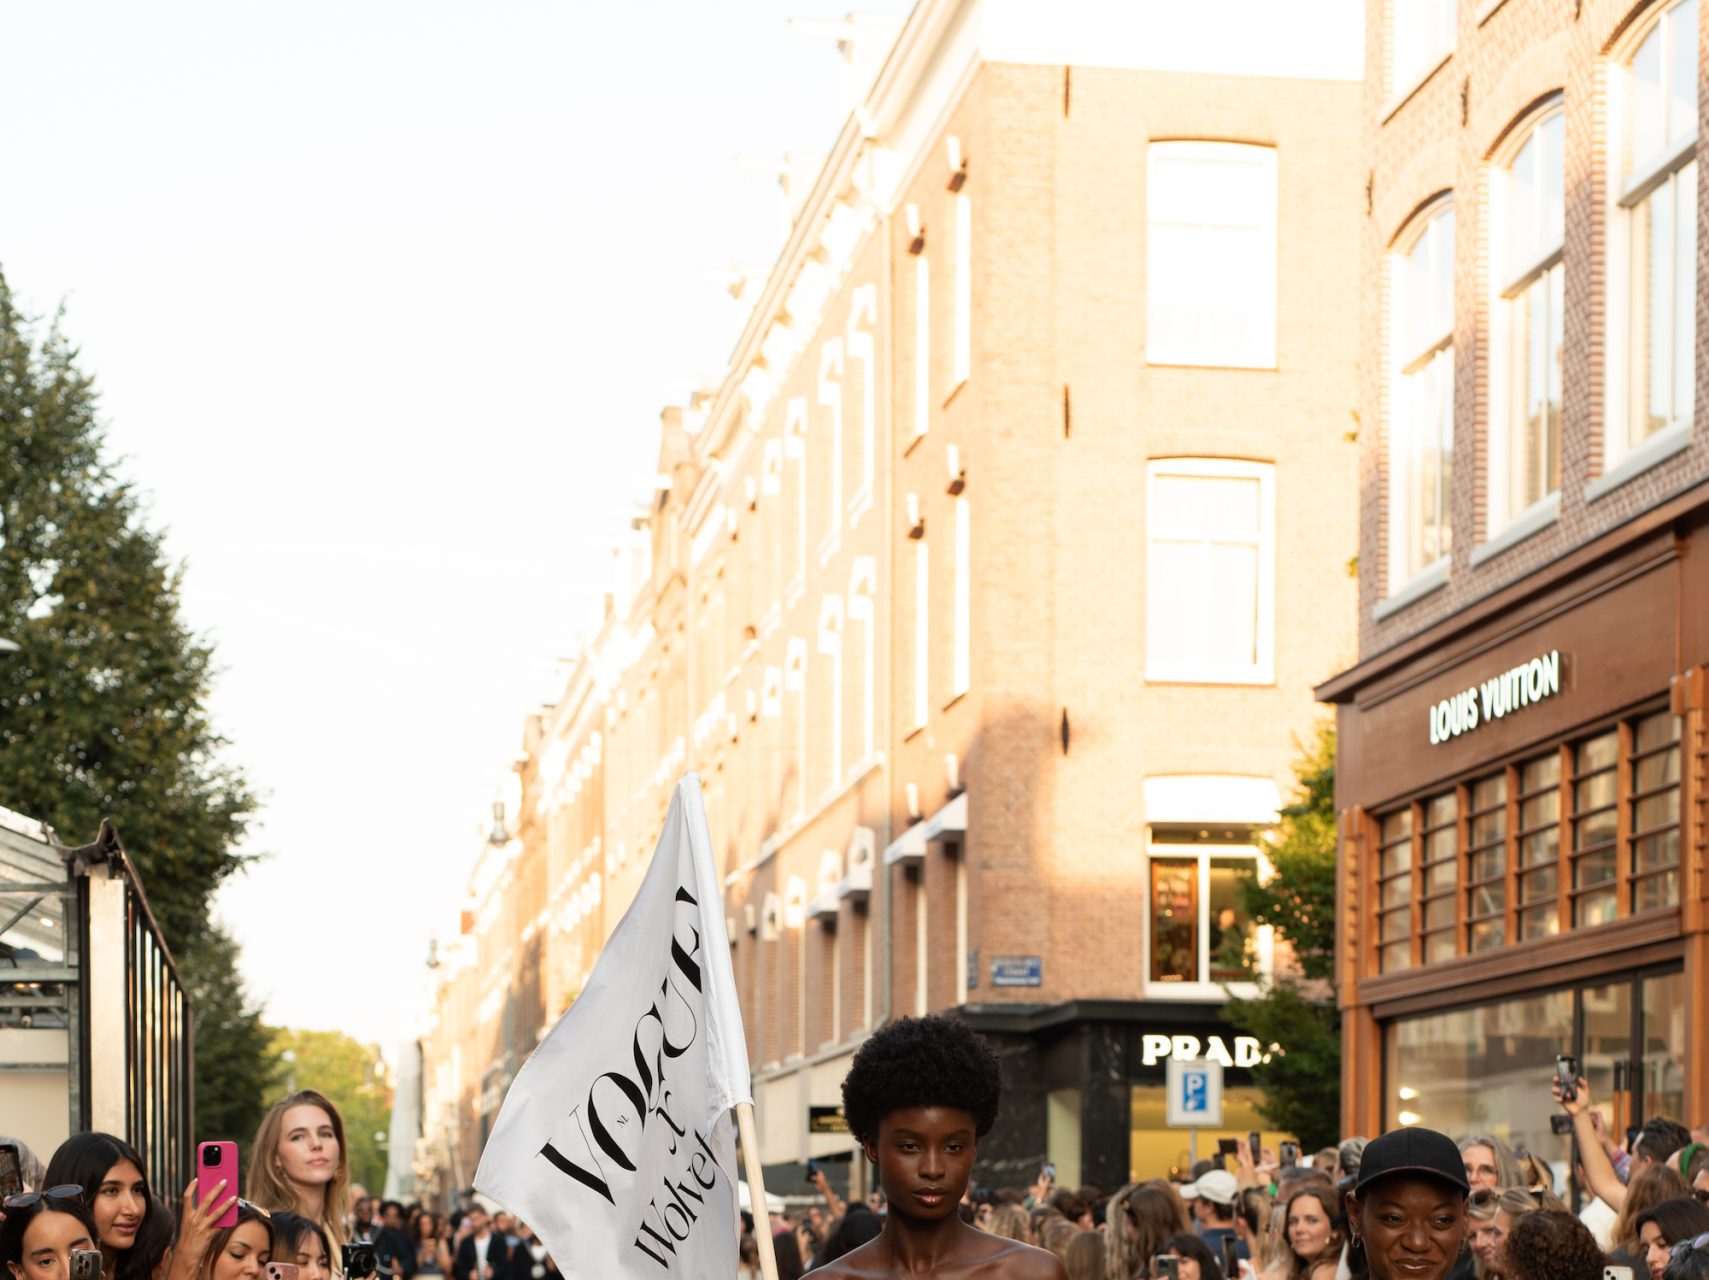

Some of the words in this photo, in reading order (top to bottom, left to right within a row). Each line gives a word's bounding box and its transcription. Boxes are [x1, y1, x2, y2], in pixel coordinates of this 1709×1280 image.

[1430, 687, 1478, 745] LOUIS
[1481, 649, 1559, 722] VUITTON
[1142, 1034, 1286, 1068] PRAD
[1186, 1074, 1203, 1096] P
[616, 1114, 630, 1129] NL
